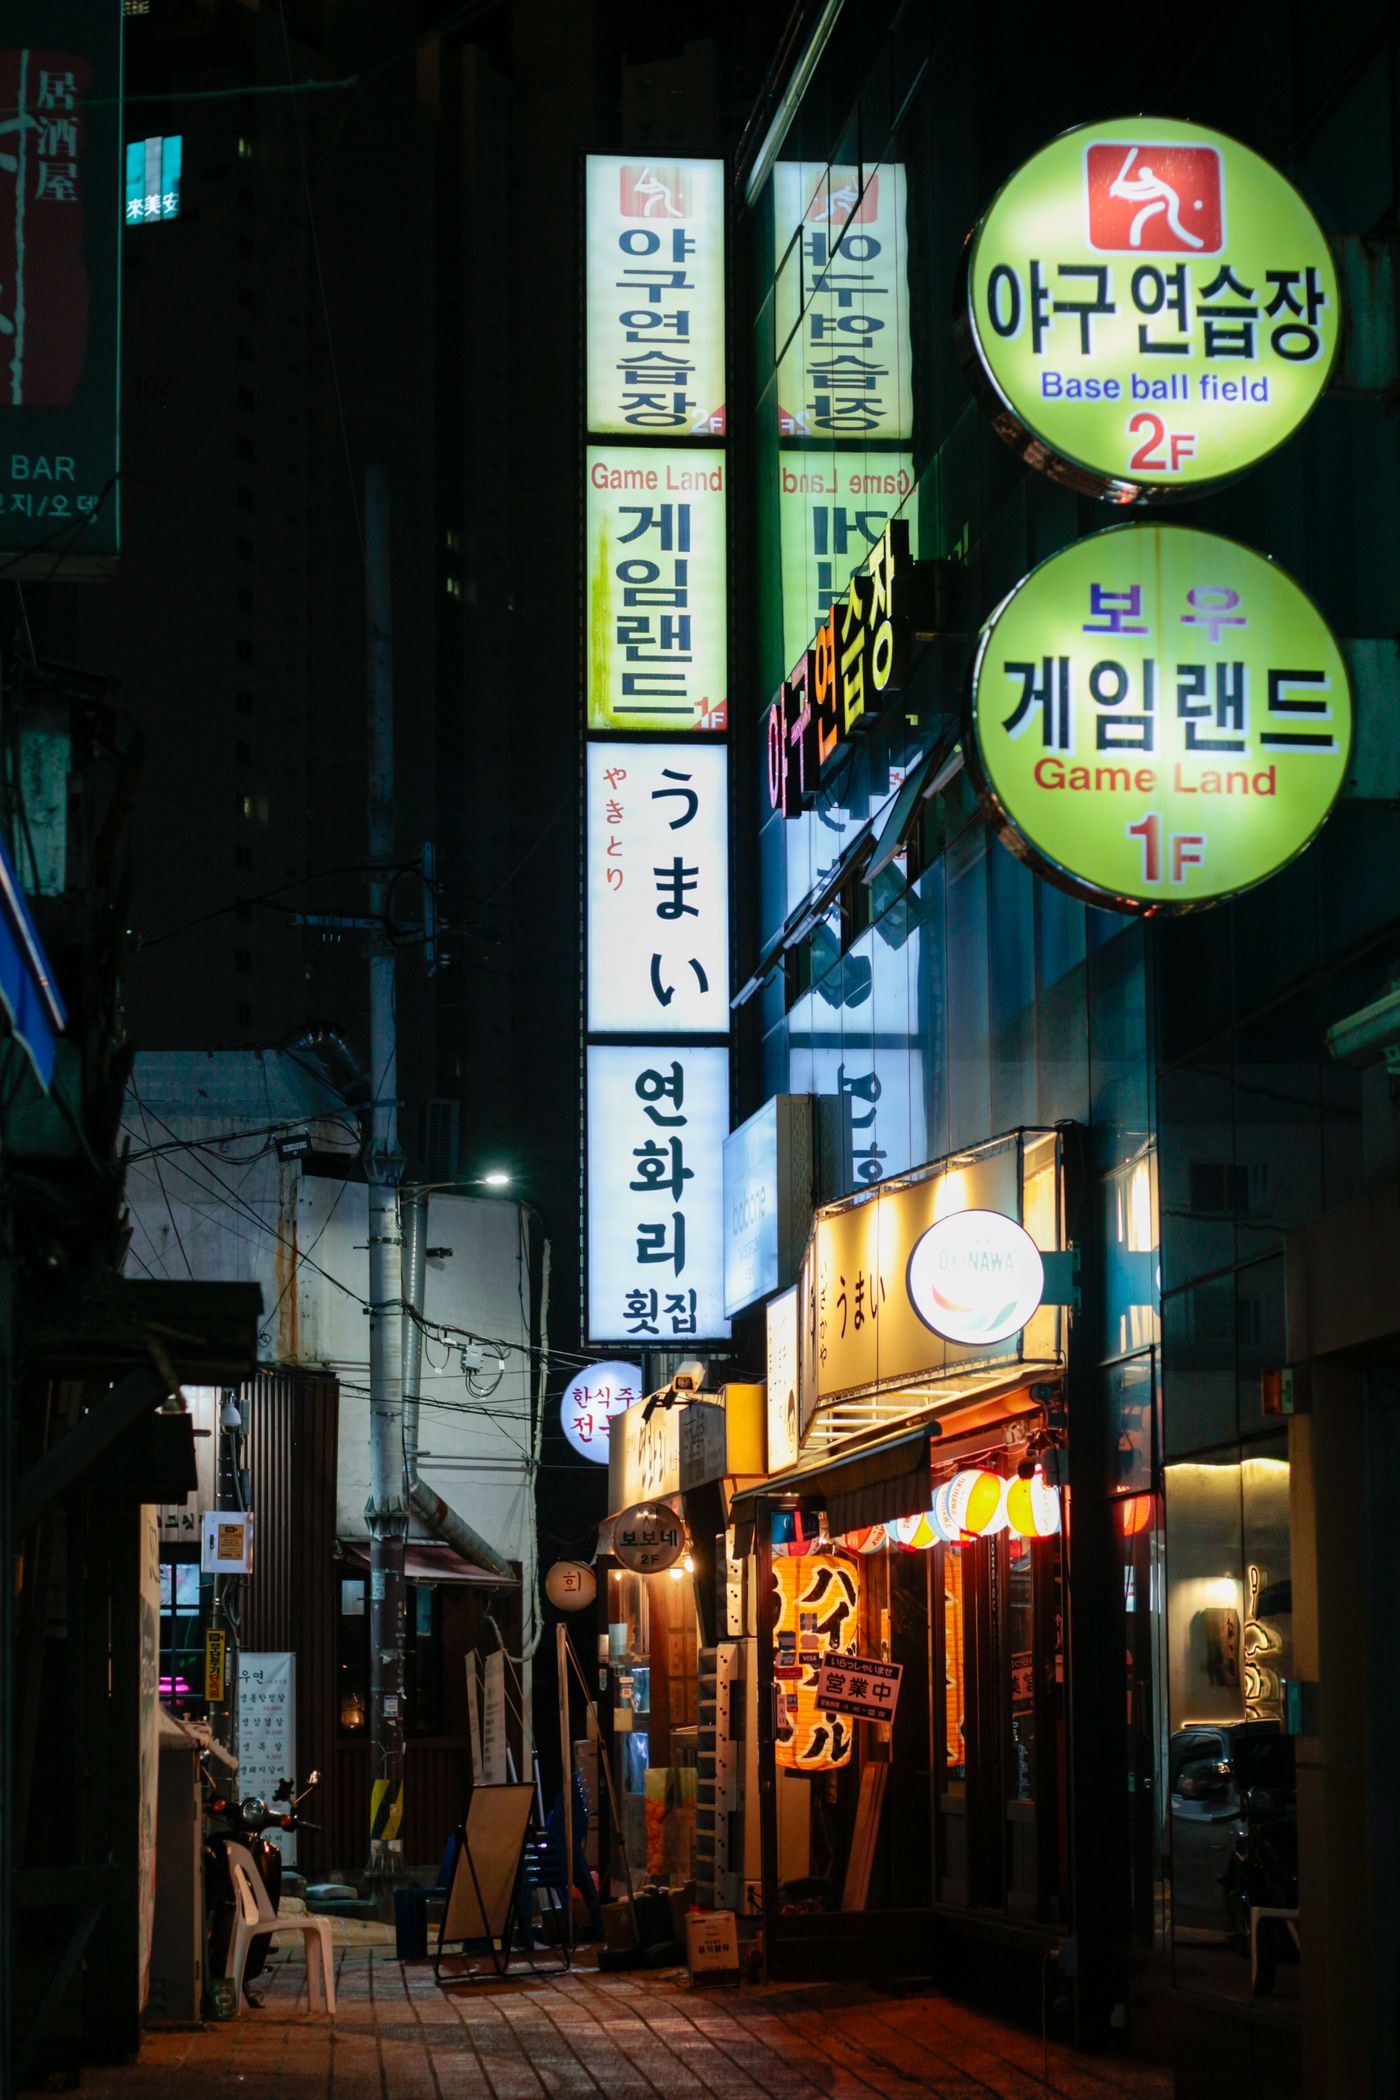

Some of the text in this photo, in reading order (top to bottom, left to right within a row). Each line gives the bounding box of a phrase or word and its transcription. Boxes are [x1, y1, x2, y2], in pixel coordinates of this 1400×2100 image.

[36, 70, 80, 201] 居酒屋
[615, 228, 697, 427] 야구연습장
[986, 258, 1325, 362] 야구연습장
[1040, 371, 1270, 402] Base ball field
[689, 408, 724, 434] 2F
[1128, 411, 1196, 471] 2F
[11, 454, 76, 480] BAR
[591, 462, 723, 492] Game Land
[612, 503, 695, 714] 게임랜드
[1002, 656, 1335, 753] 게임랜드
[1033, 757, 1277, 797] Game Land
[603, 767, 628, 891] やきとり
[1129, 814, 1204, 882] 1F
[650, 768, 709, 1008] うまい
[629, 1060, 695, 1279] 연화리
[938, 1248, 1015, 1273] OKNAWA
[622, 1287, 698, 1335] 횟집
[836, 1270, 886, 1340] うまい
[572, 1386, 643, 1409] 한식주
[570, 1413, 611, 1444] 전
[620, 1529, 677, 1547] 보보네
[826, 1672, 891, 1702] 営業中
